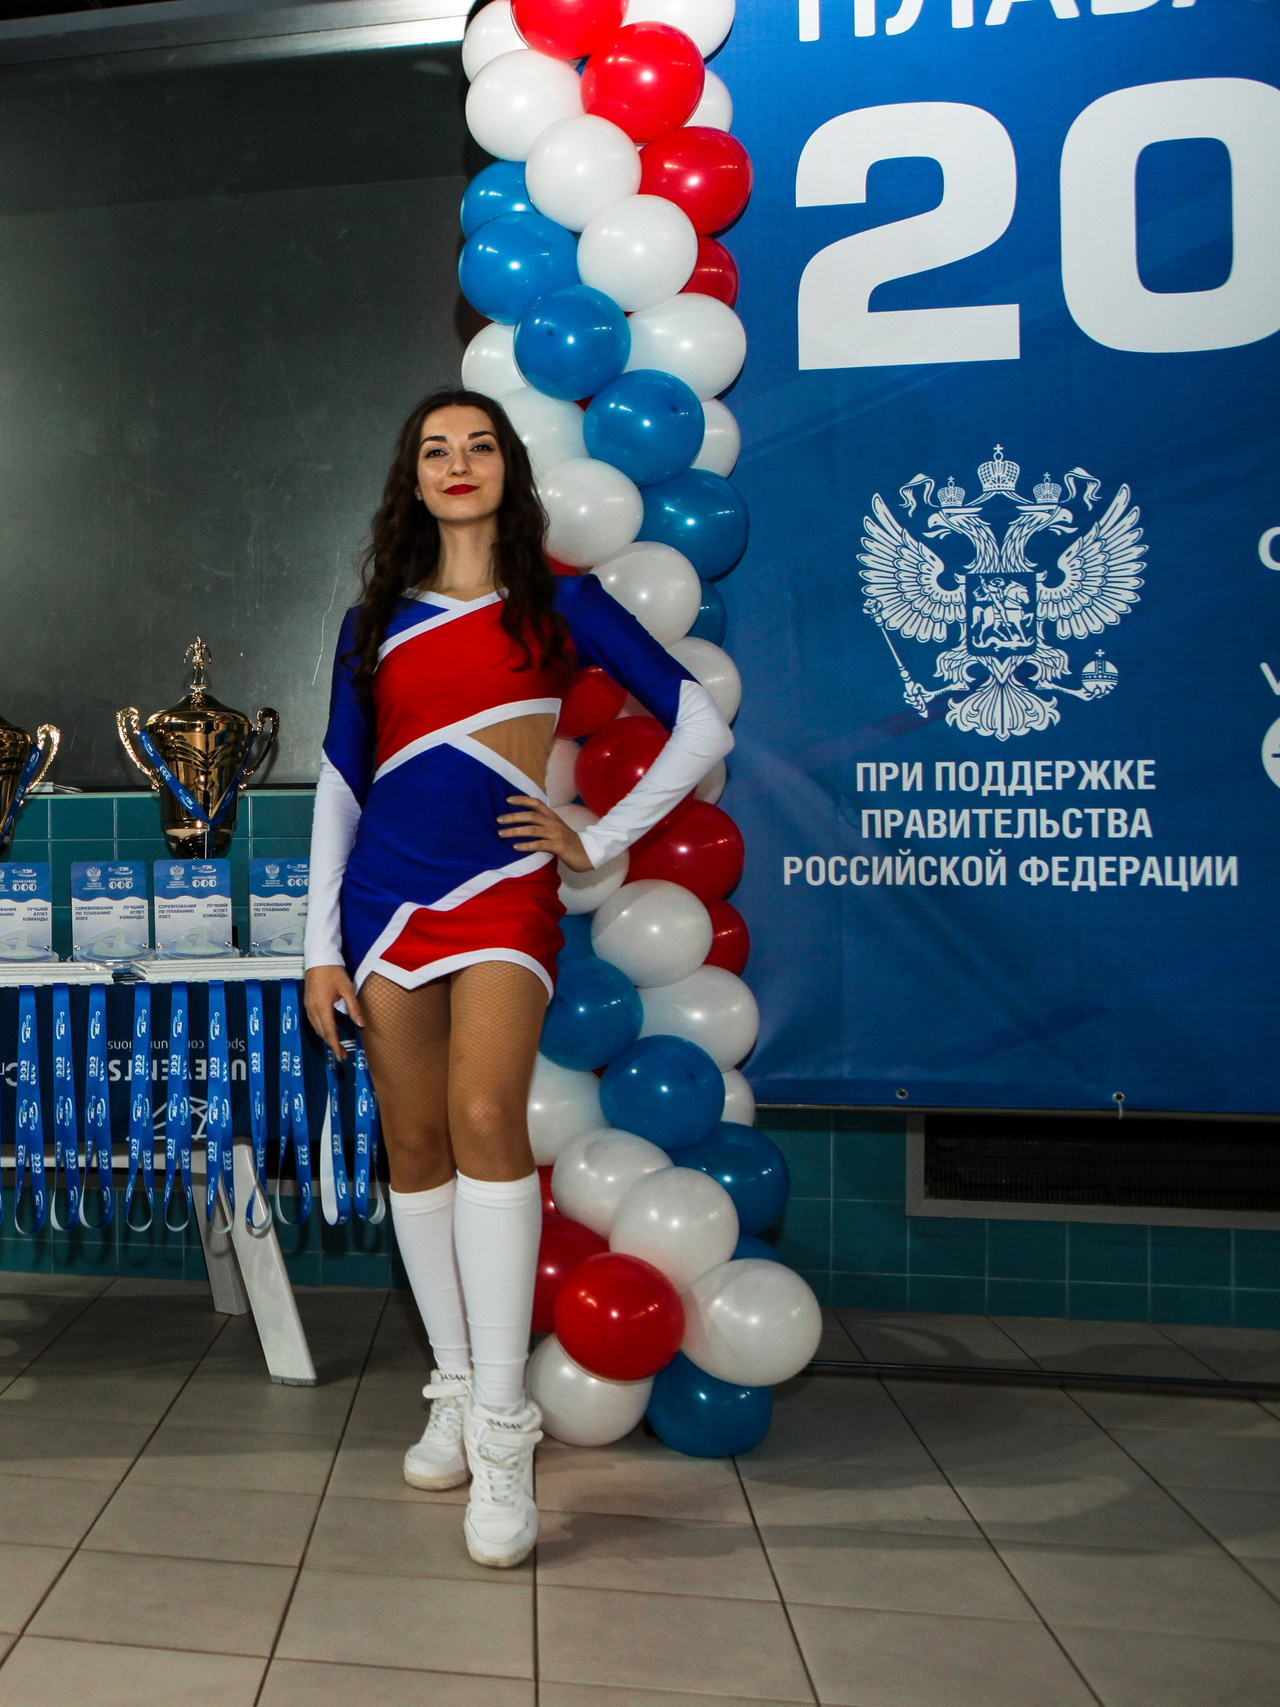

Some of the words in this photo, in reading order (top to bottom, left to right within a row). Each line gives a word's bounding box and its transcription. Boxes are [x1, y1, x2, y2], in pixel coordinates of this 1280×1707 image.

[856, 762, 923, 792] ПРИ
[935, 760, 1156, 796] ПОДДЕРЖКЕ
[861, 808, 1153, 838] ПРАВИТЕЛЬСТВА
[782, 848, 1007, 886] РОССИЙСКОЙ
[1018, 856, 1238, 892] ФЕДЕРАЦИИ
